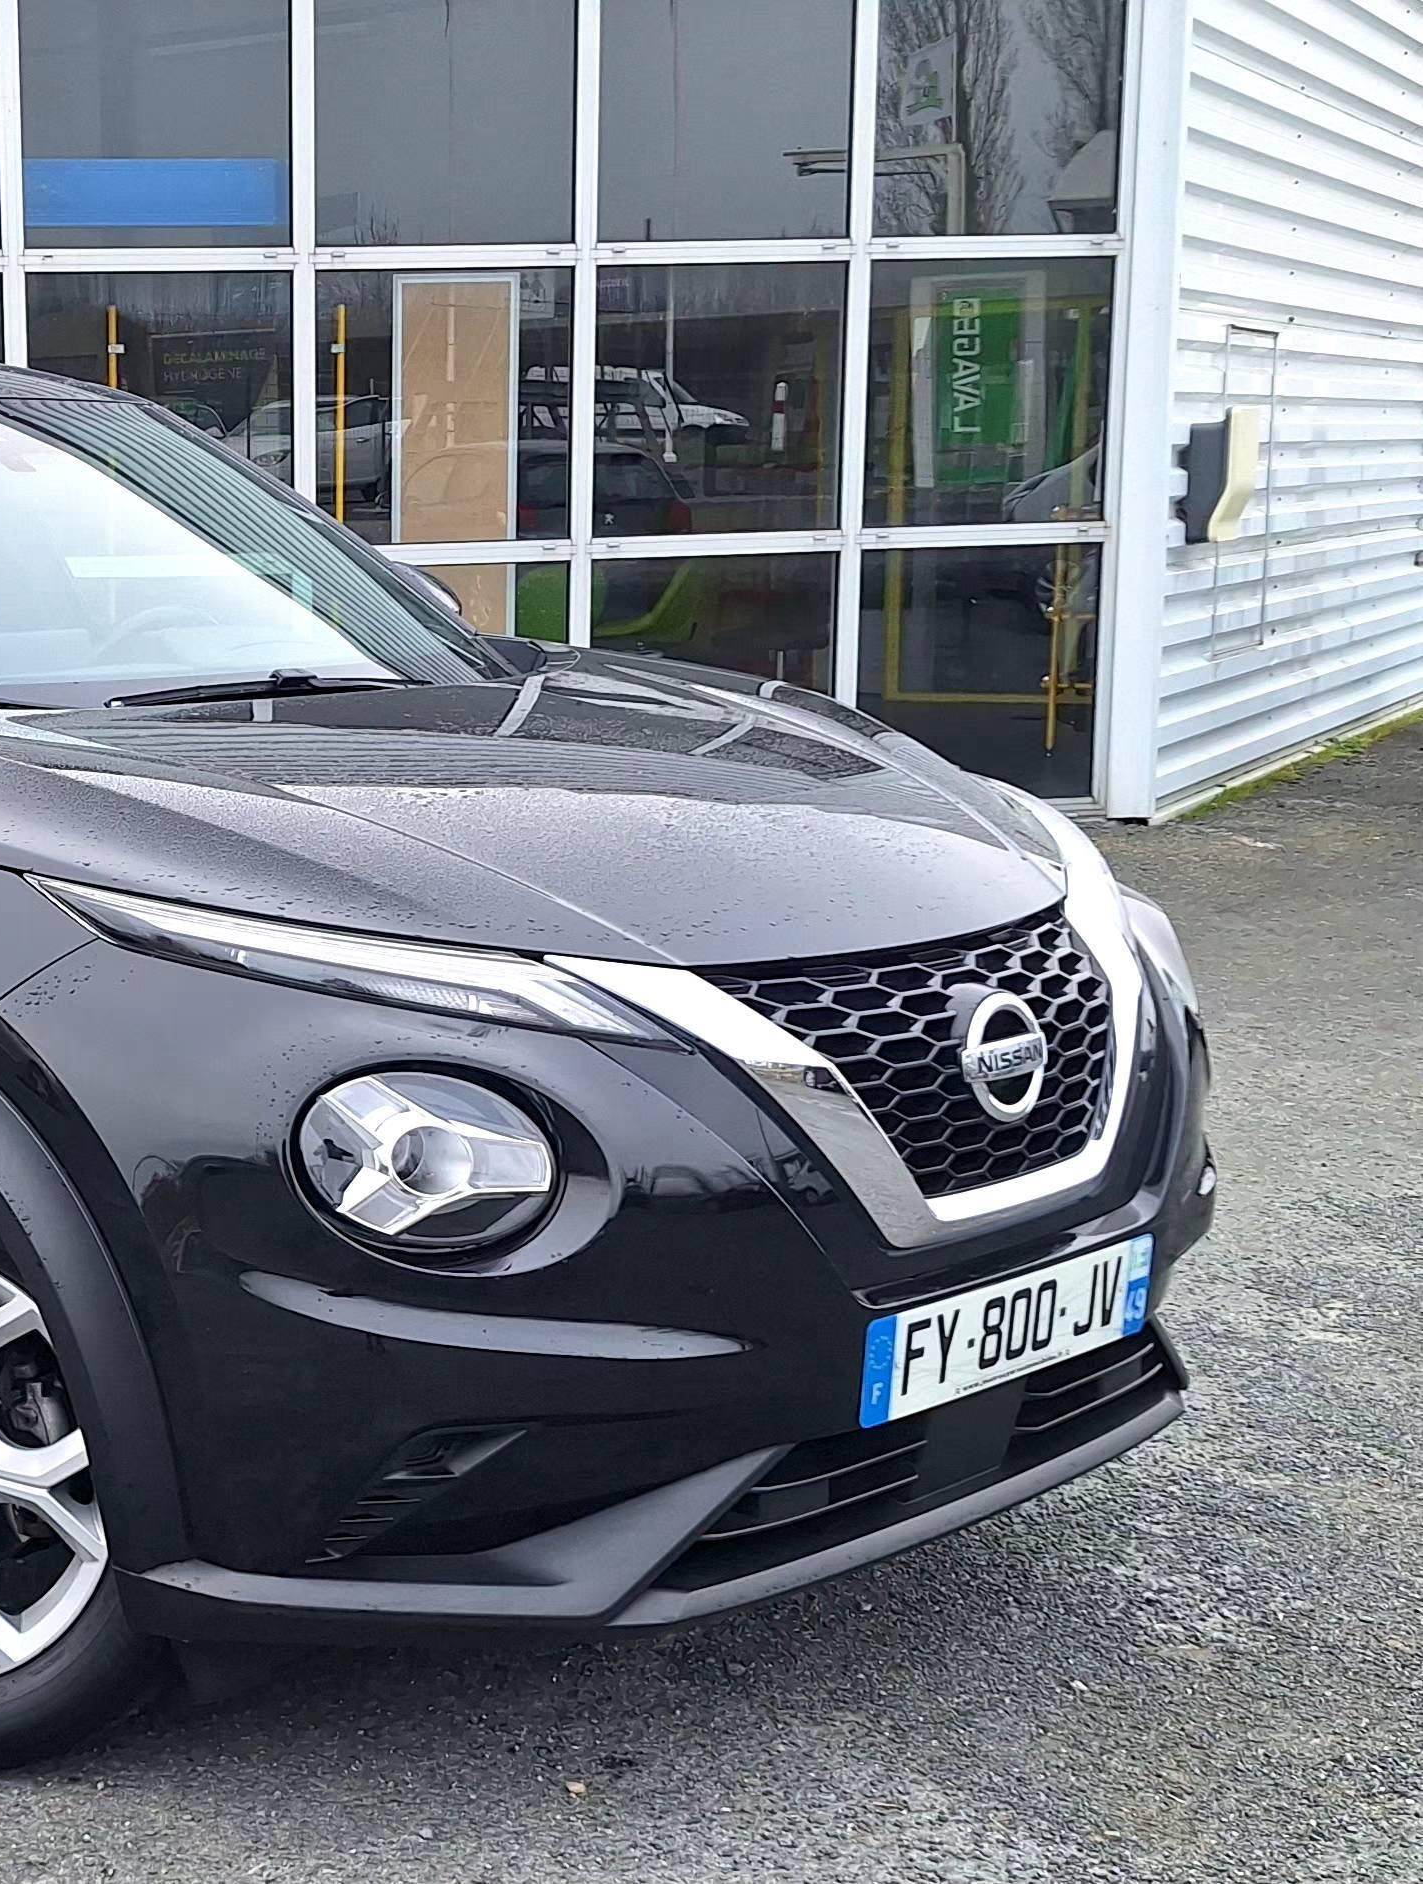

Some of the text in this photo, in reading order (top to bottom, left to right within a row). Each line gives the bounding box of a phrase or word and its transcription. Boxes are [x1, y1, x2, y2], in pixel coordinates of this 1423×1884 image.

[977, 1044, 1043, 1073] NISSAN
[871, 1383, 883, 1405] F
[1126, 1287, 1147, 1323] 49
